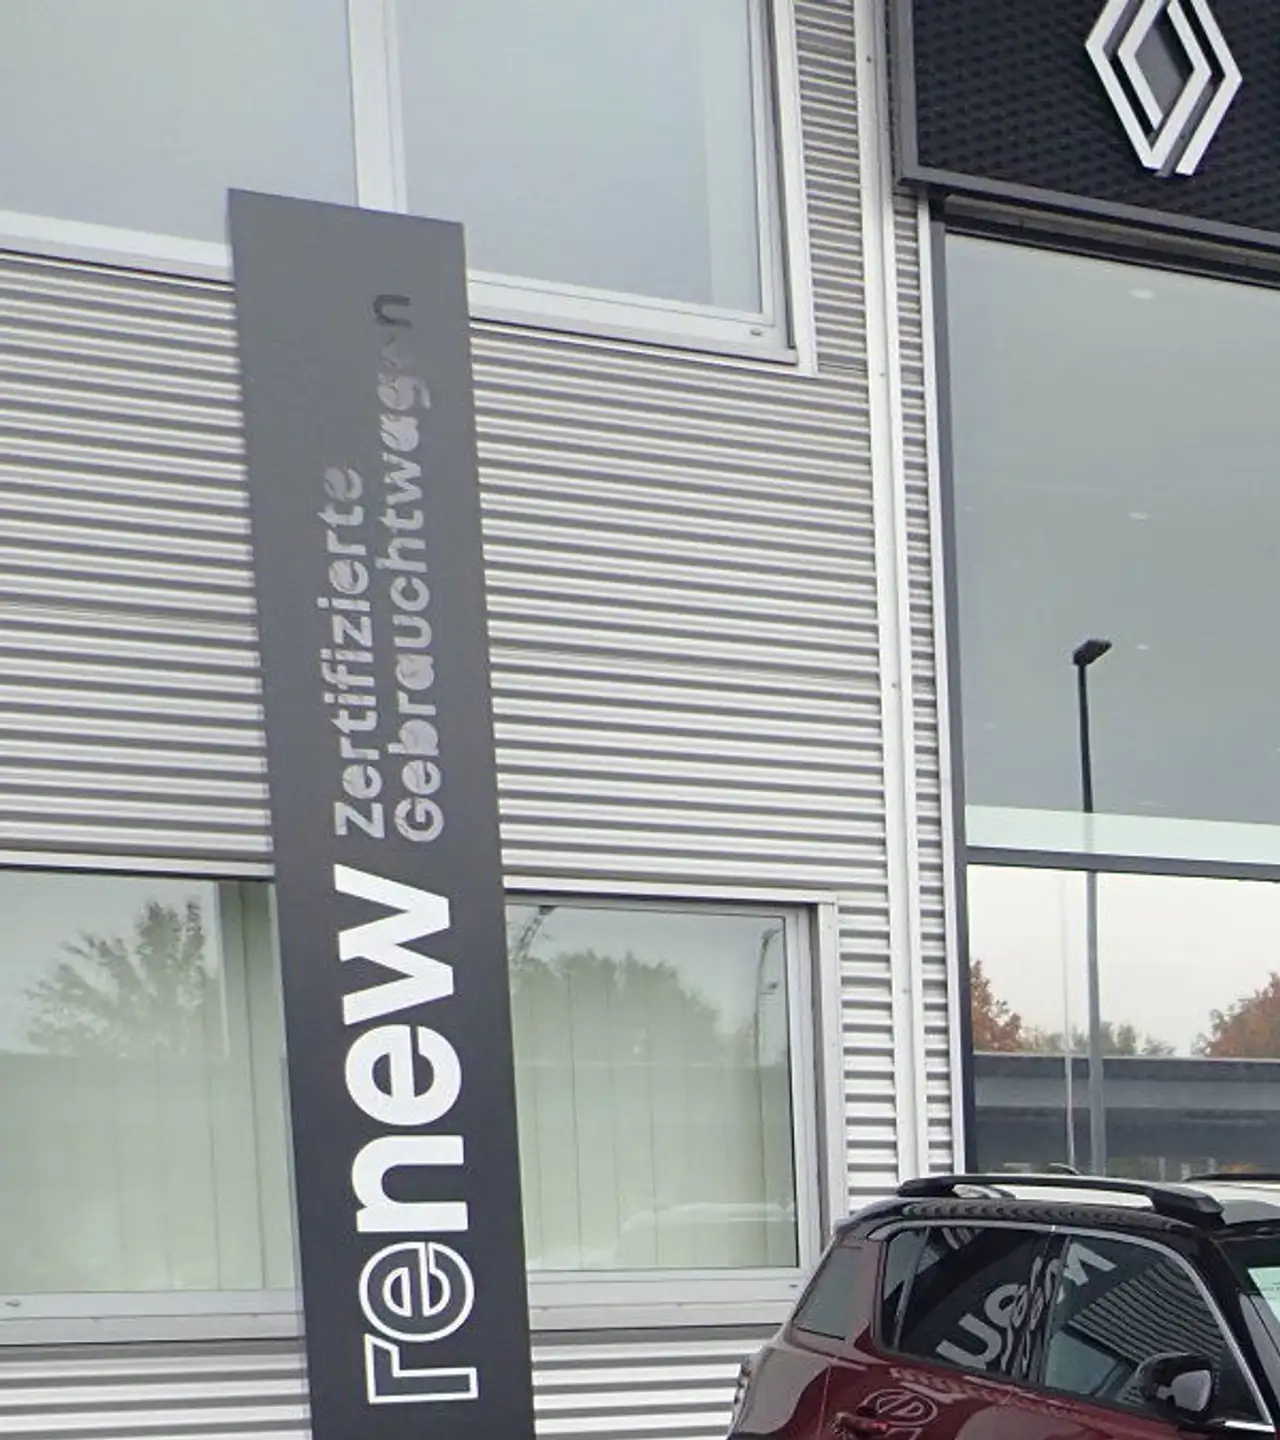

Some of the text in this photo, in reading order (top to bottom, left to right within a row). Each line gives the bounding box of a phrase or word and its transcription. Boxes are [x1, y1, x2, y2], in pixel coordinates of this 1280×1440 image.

[317, 466, 386, 840] Zertifizierte
[373, 294, 443, 842] Gebrauchtwagn
[334, 864, 479, 1404] renew
